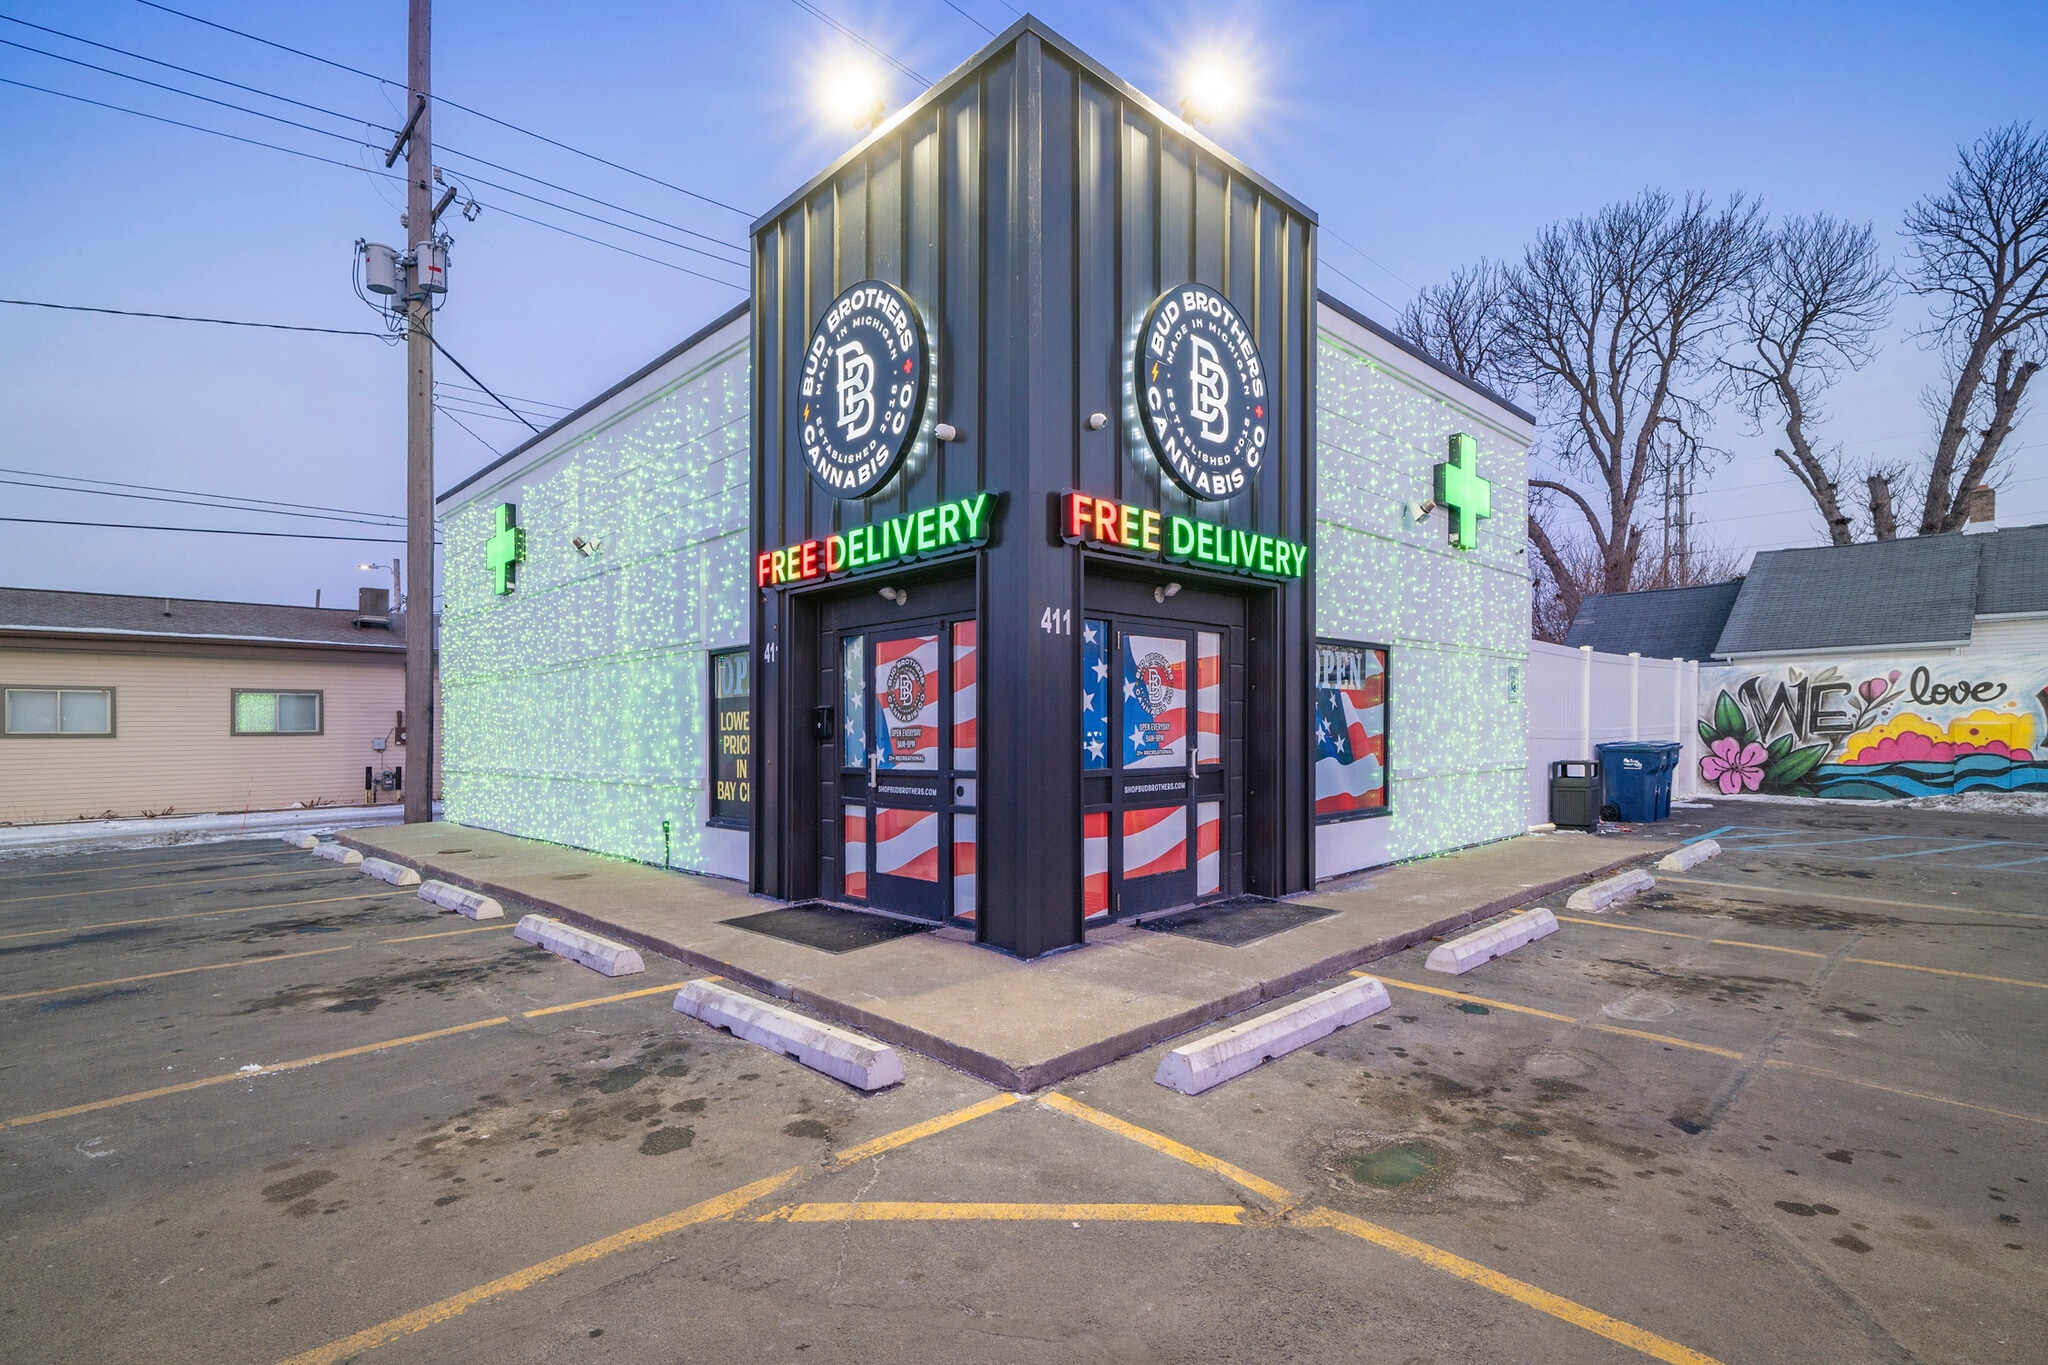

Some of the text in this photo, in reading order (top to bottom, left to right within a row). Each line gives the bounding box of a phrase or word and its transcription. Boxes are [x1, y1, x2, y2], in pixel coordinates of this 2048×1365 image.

[803, 288, 913, 396] BUD BROTHERS
[816, 316, 898, 395] MADE IN MICHIGAN
[1151, 291, 1264, 398] BUD BROTHERS
[1166, 318, 1250, 395] MADE IN MICHIGAN
[815, 416, 877, 464] ESTABLISHED
[1148, 386, 1265, 494] CANNABIS CO
[1166, 388, 1231, 466] ESTABLISHED
[804, 424, 889, 489] CANNABIS
[758, 493, 987, 587] FREE DELIVERY
[1071, 493, 1307, 577] FREE DELIVERY
[1041, 606, 1070, 635] 411
[764, 641, 778, 663] 41
[888, 668, 897, 686] BUD
[897, 658, 925, 684] BROTHERS
[721, 655, 750, 695] OP
[888, 695, 918, 721] CANNABIS
[1139, 722, 1170, 731] OPEN EVERYDAY
[1738, 666, 2007, 743] WE love
[891, 728, 922, 737] OPEN EVERYDAY
[717, 780, 737, 801] BAY
[736, 759, 747, 779] IN
[878, 785, 937, 796] SHOPBUDBROTHERS.COM
[1124, 782, 1186, 794] SHOPBUDBROTHERS.COM
